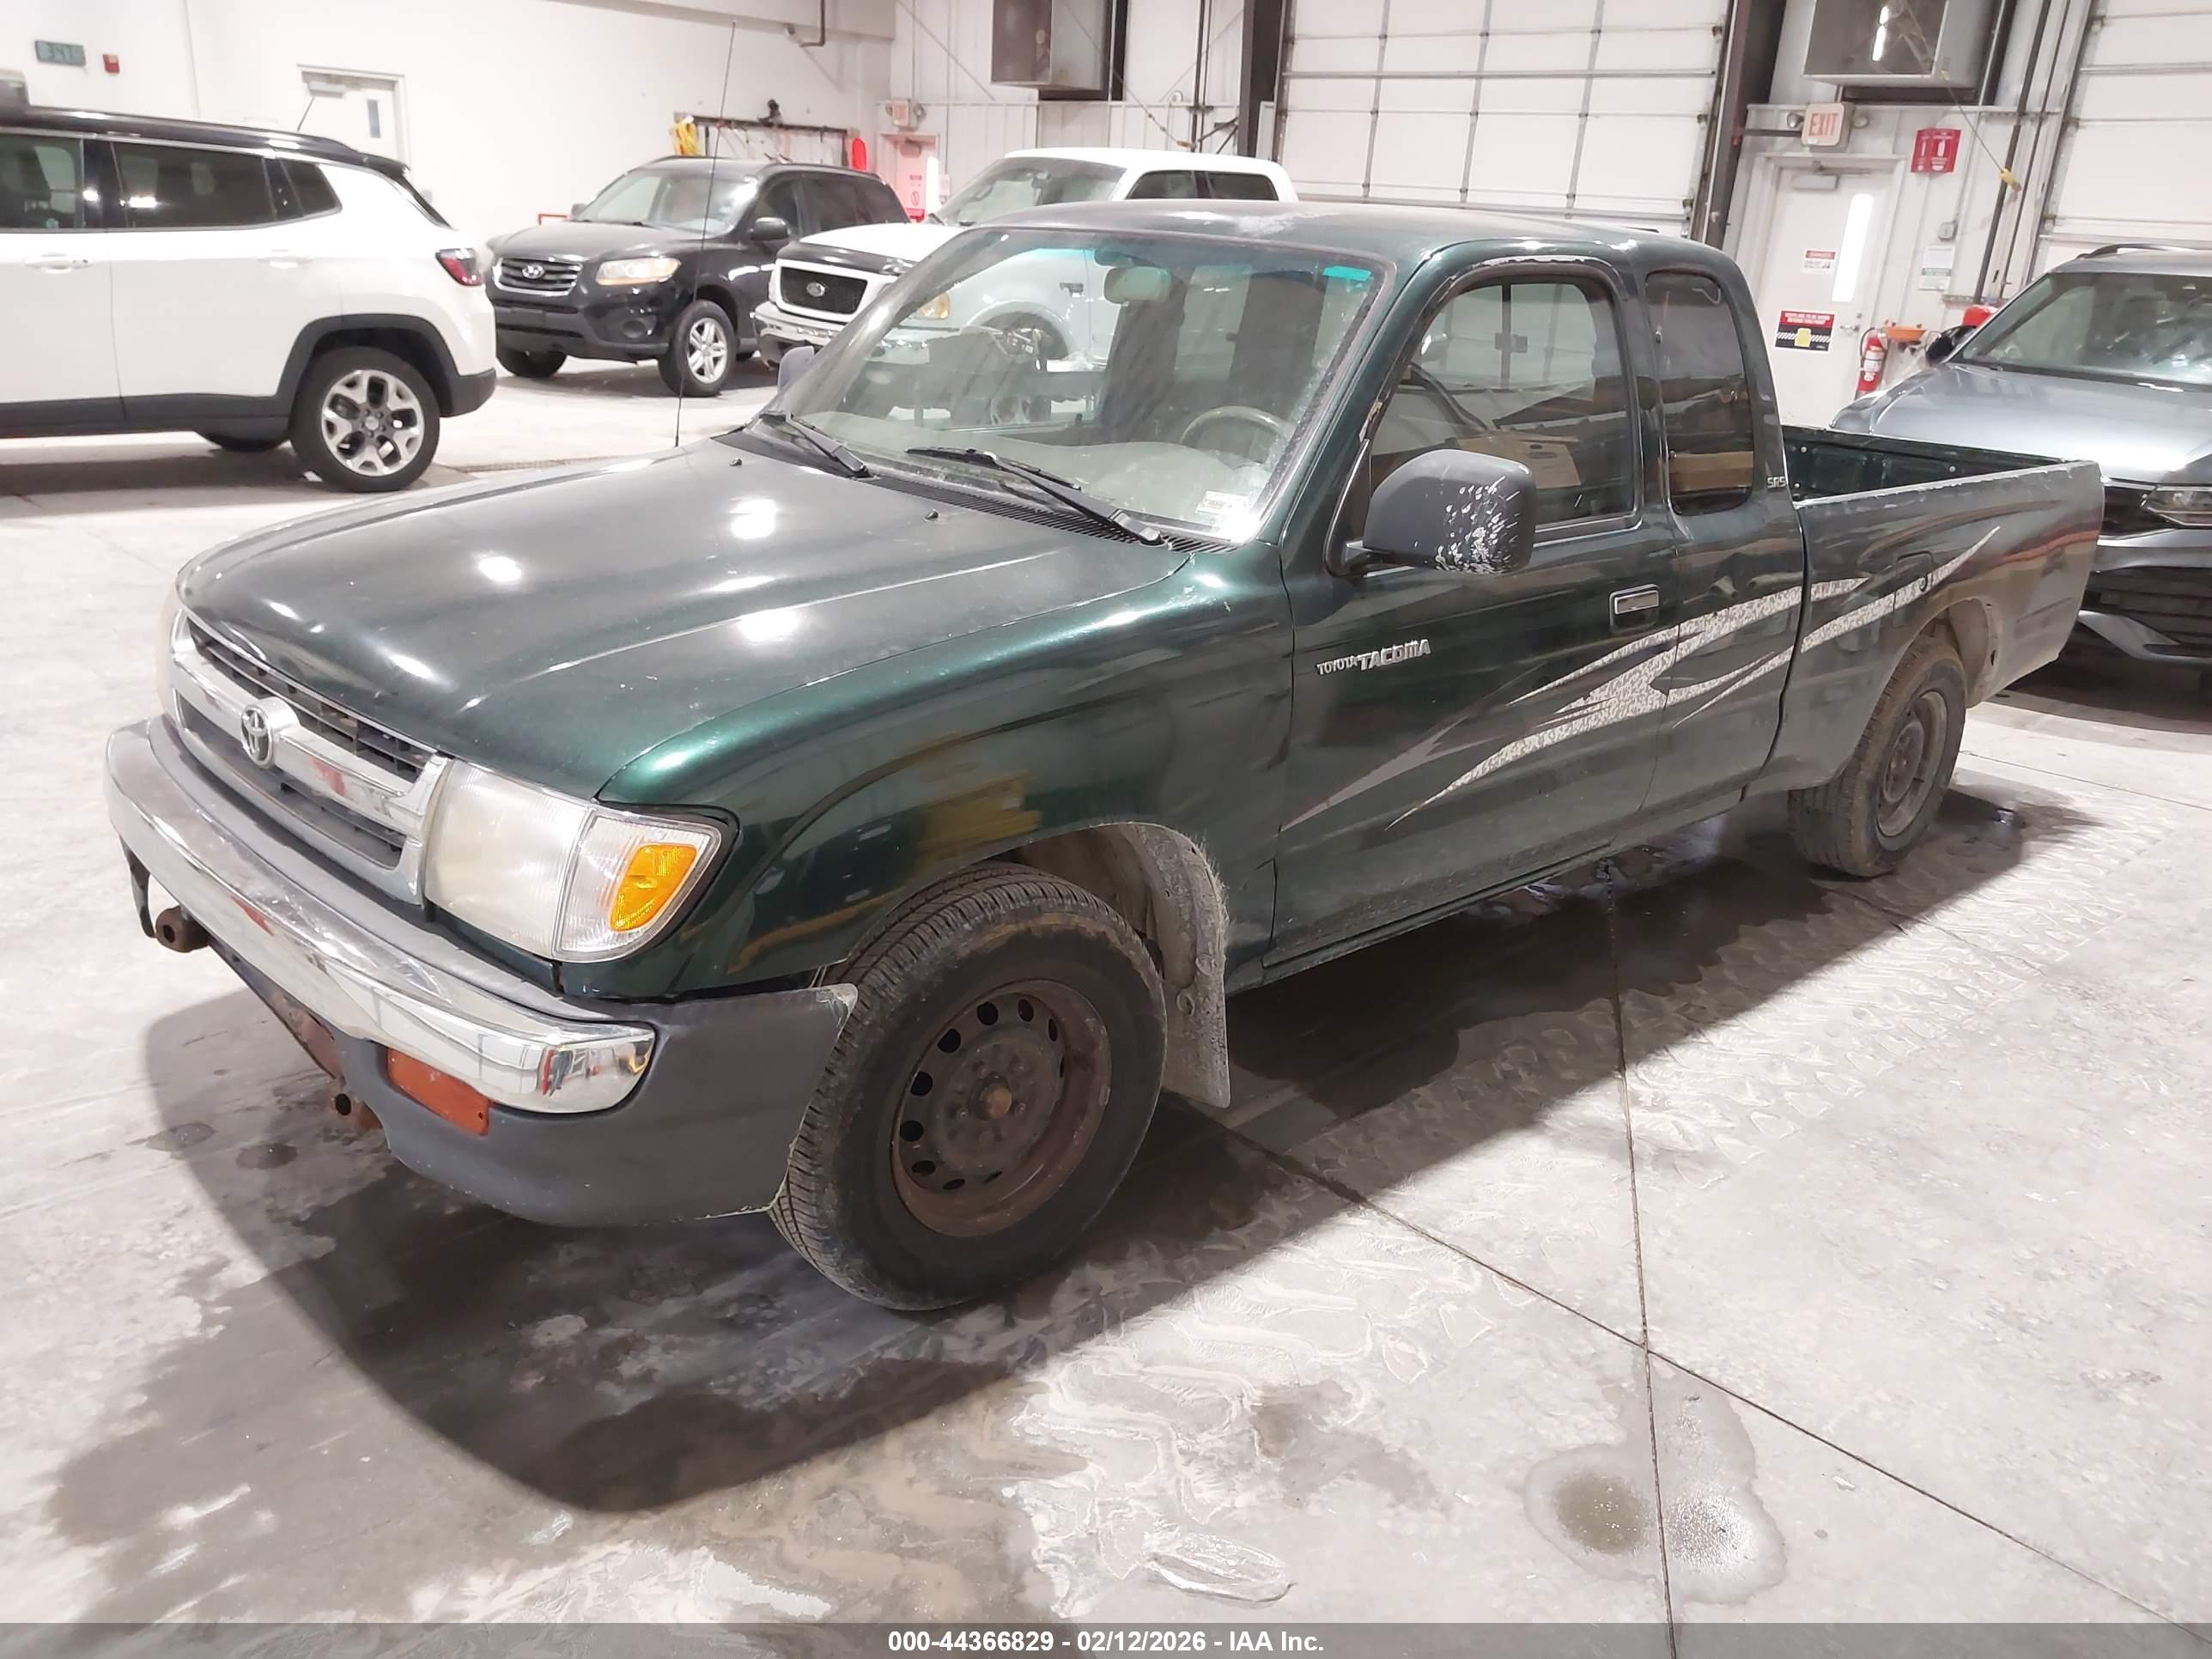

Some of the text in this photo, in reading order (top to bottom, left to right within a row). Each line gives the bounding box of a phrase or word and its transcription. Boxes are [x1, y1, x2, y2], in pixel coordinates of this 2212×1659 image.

[1808, 112, 1838, 137] EXIT
[1317, 639, 1431, 675] TOYOTA TACOMA
